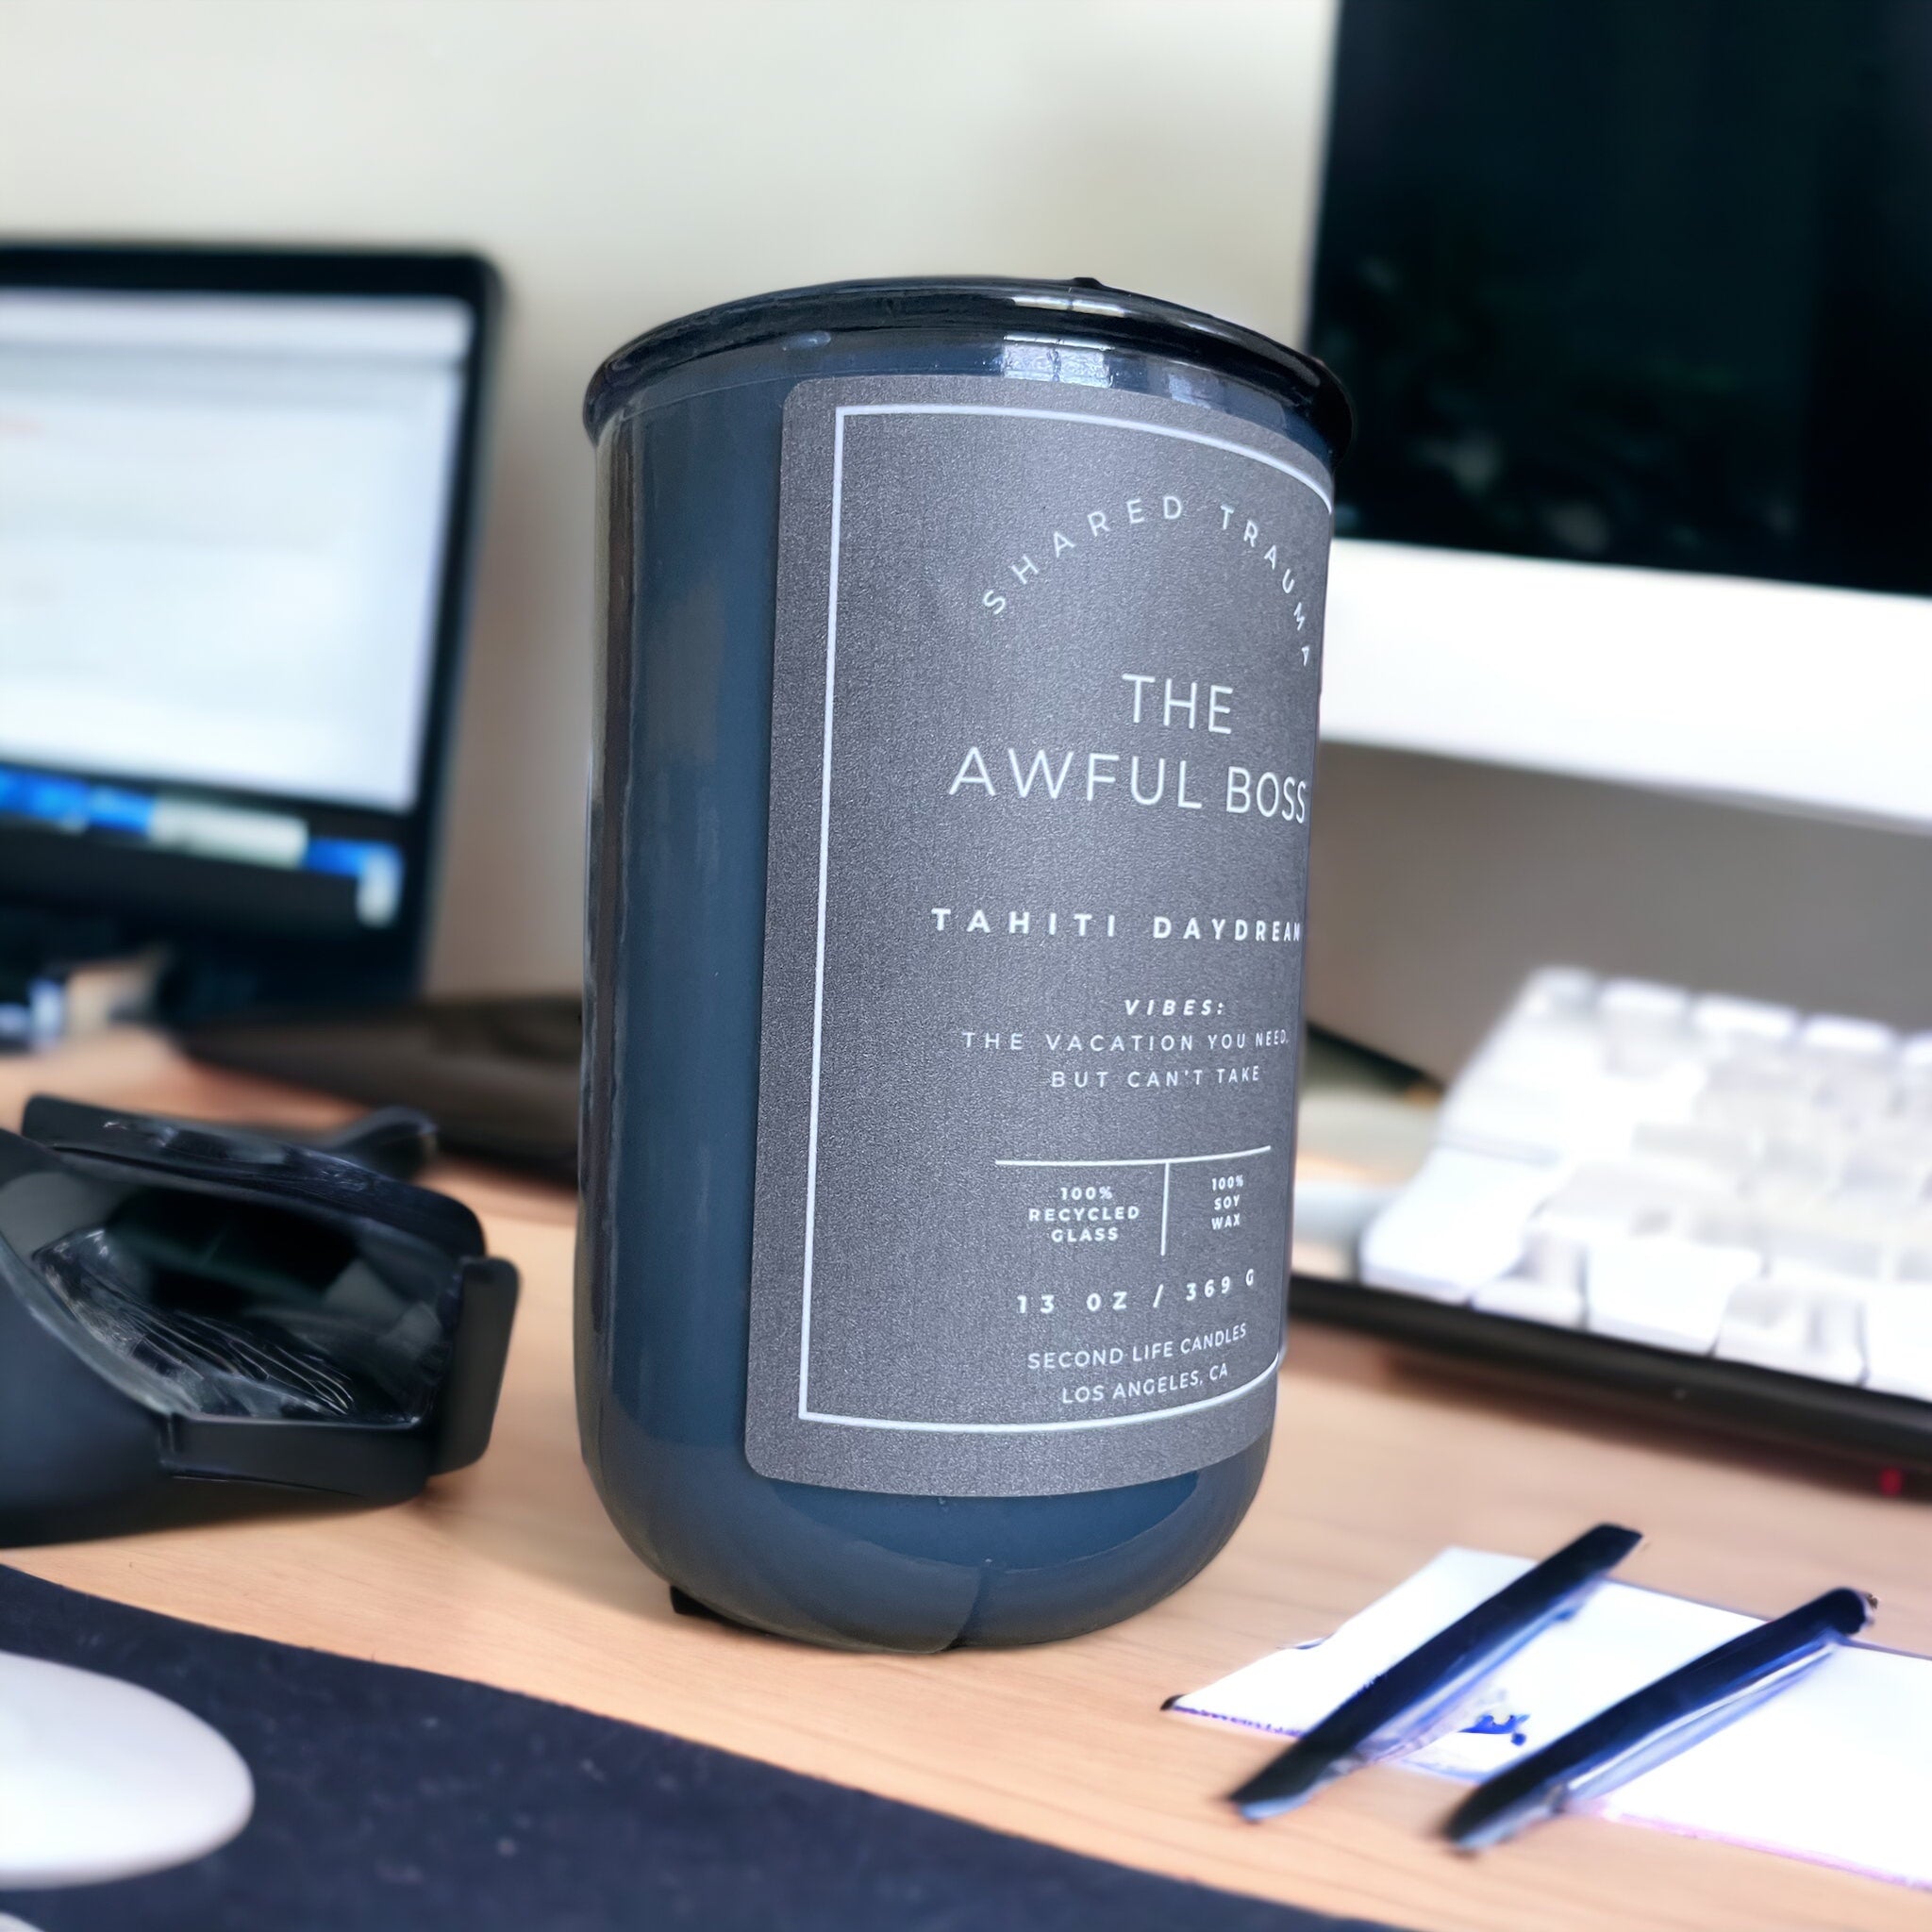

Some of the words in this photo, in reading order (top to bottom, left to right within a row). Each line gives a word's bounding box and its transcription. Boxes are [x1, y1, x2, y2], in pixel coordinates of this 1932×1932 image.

[982, 495, 1182, 615] SHARED
[1220, 504, 1310, 666] TRAUMA
[1121, 673, 1234, 735] THE
[948, 746, 1203, 809] AWFUL
[1226, 765, 1307, 824] BOSS
[930, 907, 1116, 938] TAHITI
[1124, 998, 1225, 1017] VIBES:
[961, 1031, 1024, 1051] THE
[1045, 1033, 1193, 1052] VACATION
[1207, 1034, 1246, 1051] YOU
[1050, 1071, 1109, 1089] BUT
[1127, 1069, 1204, 1088] CAN'T
[1215, 1065, 1260, 1085] TAKE
[1059, 1186, 1113, 1201] 100%
[1210, 1174, 1244, 1191] 100%
[1213, 1194, 1241, 1211] SOY
[1027, 1205, 1141, 1223] RECYCLED
[1210, 1213, 1241, 1230] WAX
[1050, 1226, 1120, 1243] GLASS
[1015, 1293, 1056, 1314] 13
[1085, 1291, 1127, 1312] OZ
[1152, 1284, 1164, 1308] /
[1184, 1274, 1231, 1302] 369
[1245, 1268, 1255, 1287] G
[1026, 1347, 1124, 1370] SECOND
[1131, 1341, 1174, 1362] LIFE
[1179, 1322, 1247, 1356] CANDLES
[1061, 1386, 1105, 1405] LOS
[1208, 1362, 1228, 1381] CA
